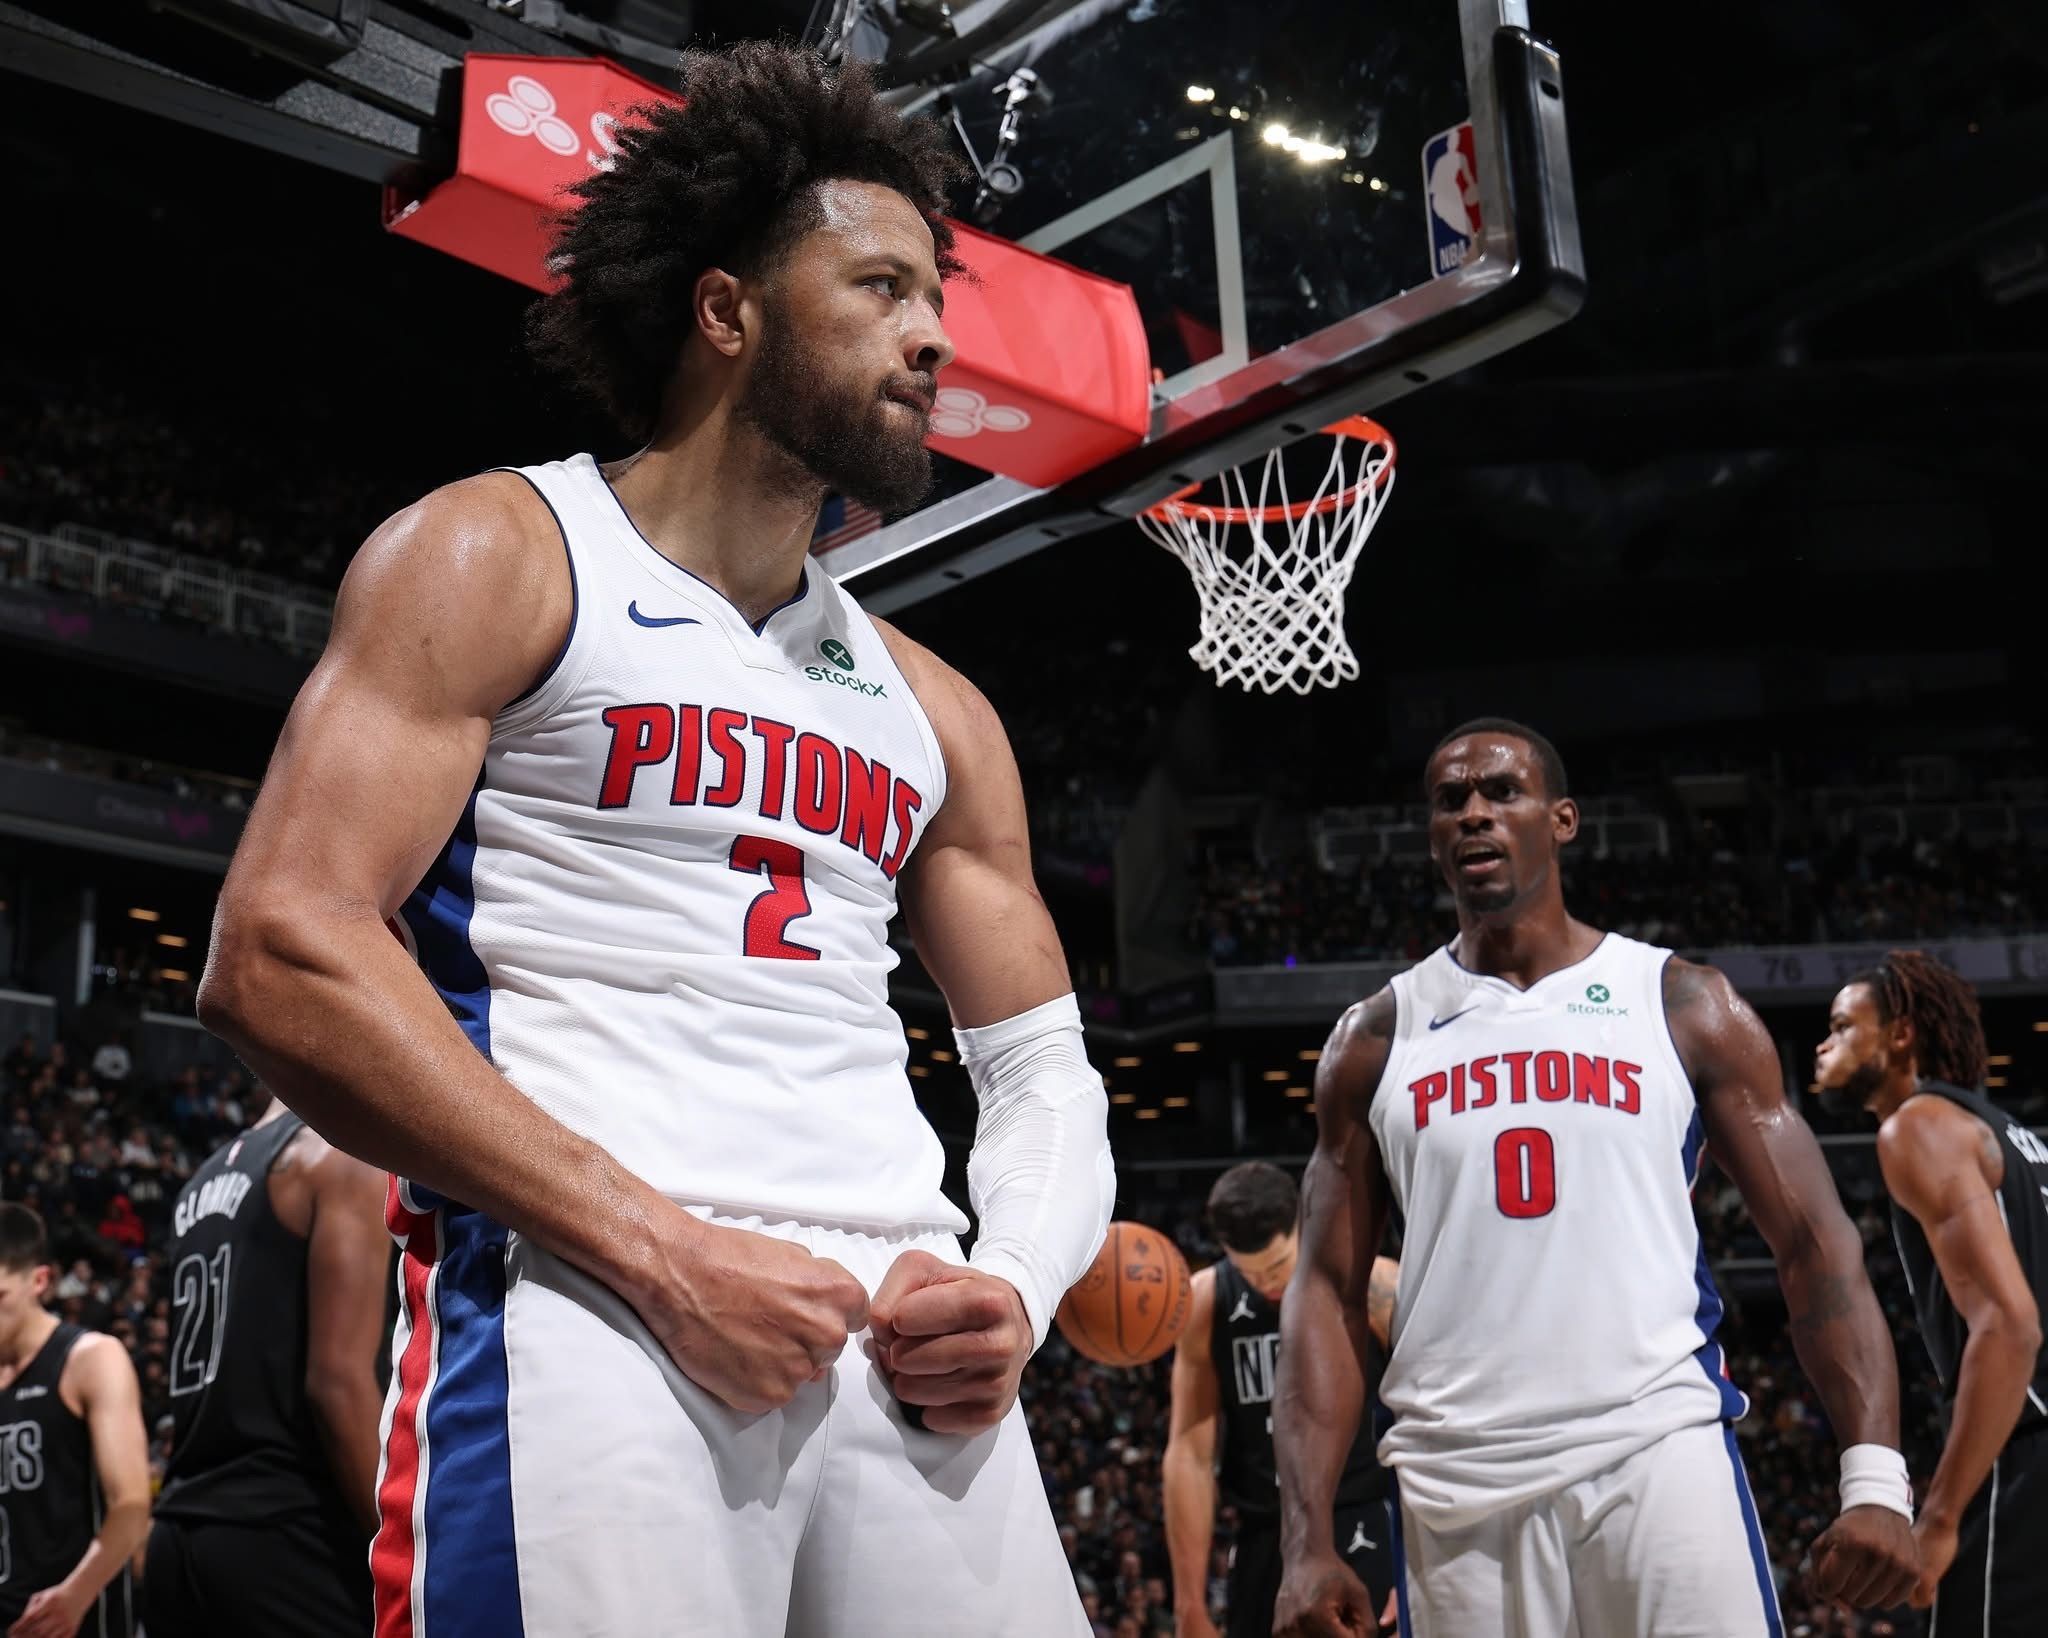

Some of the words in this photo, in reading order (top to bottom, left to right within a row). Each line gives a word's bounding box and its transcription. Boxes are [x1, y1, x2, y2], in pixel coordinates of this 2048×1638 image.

[1440, 238, 1467, 272] NBA
[804, 666, 889, 700] StockX
[597, 702, 923, 882] PISTONS
[728, 833, 822, 961] 2
[1567, 1002, 1629, 1017] StockX
[1408, 1050, 1643, 1133] PISTONS
[1493, 1126, 1557, 1219] 0
[168, 1241, 232, 1398] 21
